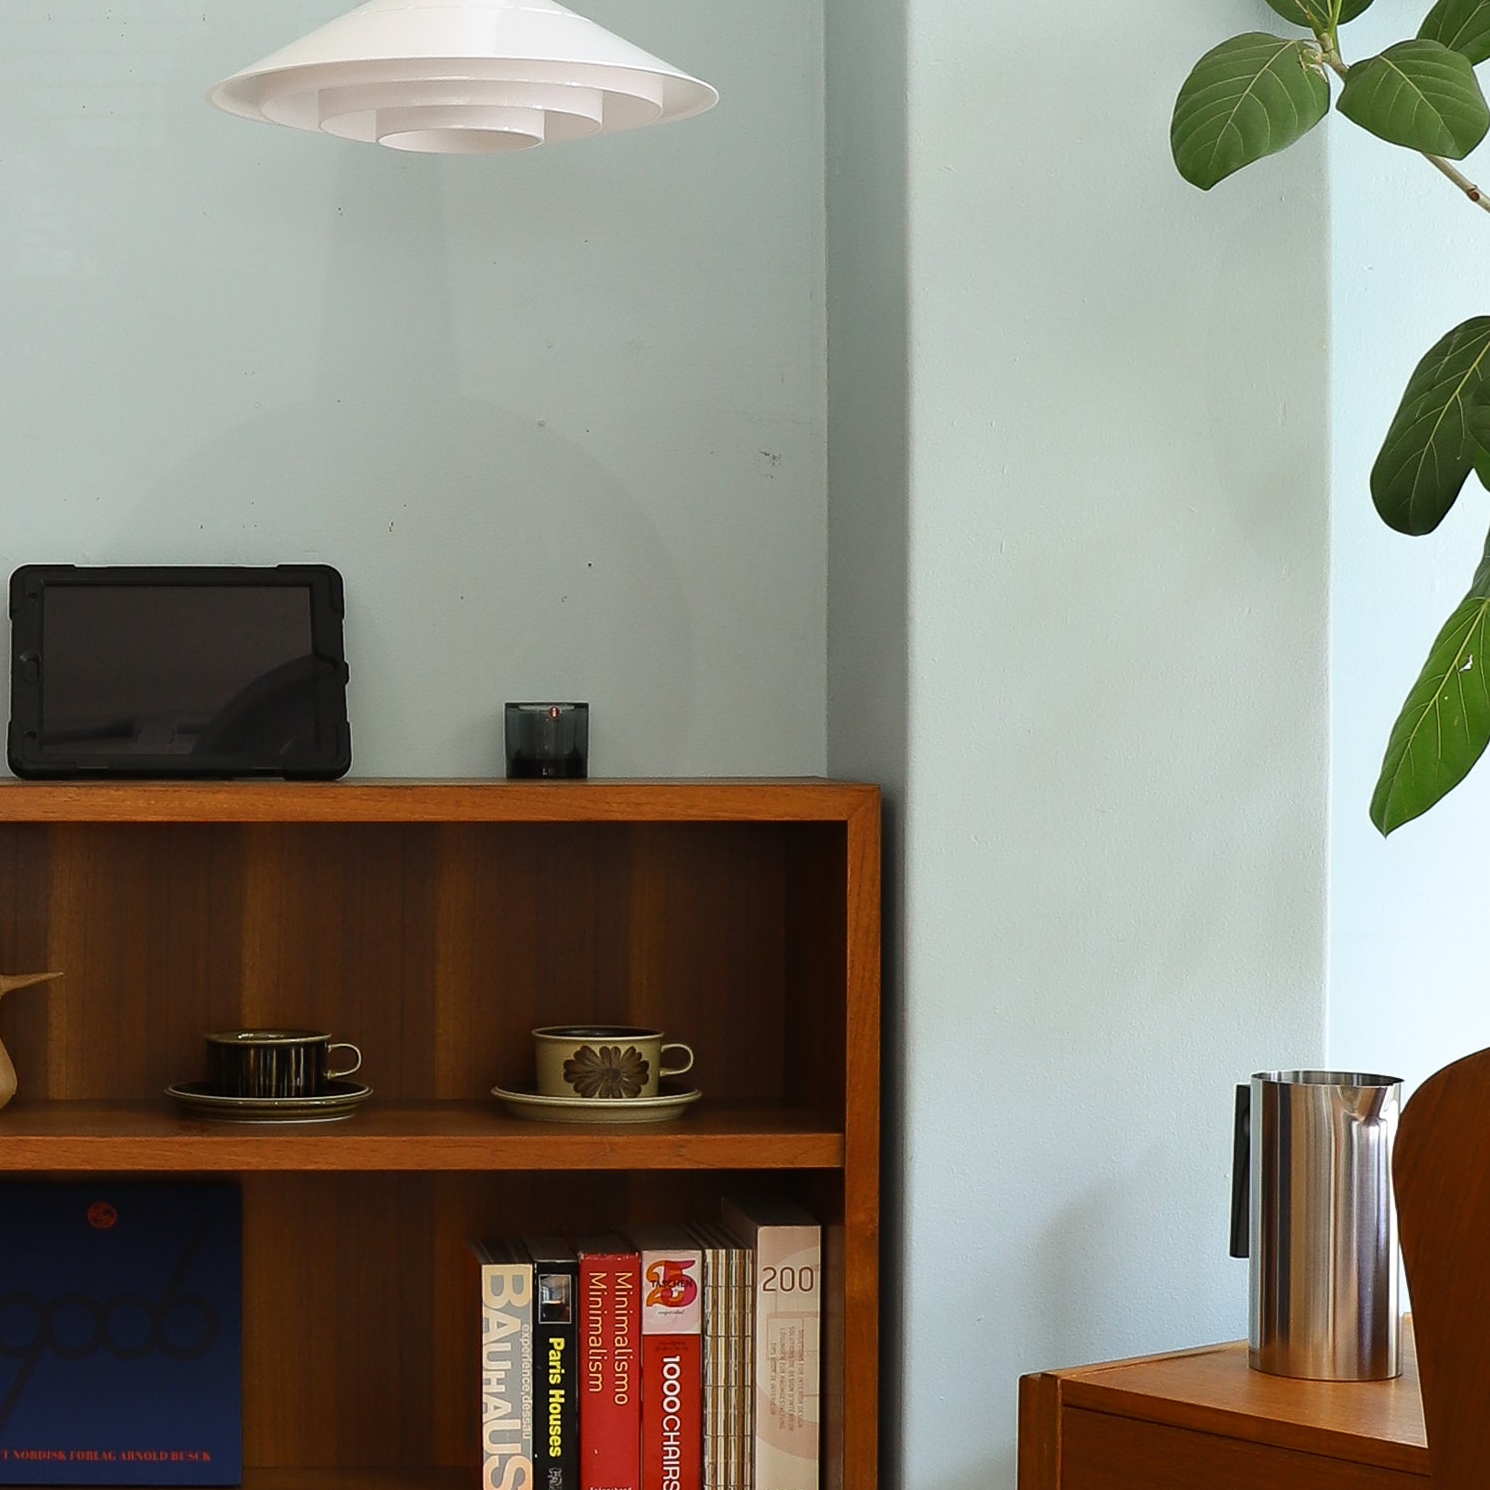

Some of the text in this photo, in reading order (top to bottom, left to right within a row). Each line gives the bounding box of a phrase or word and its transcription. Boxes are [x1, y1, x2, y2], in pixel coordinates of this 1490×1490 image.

[588, 1272, 608, 1393] Minimalism
[614, 1271, 629, 1406] Minimalismo
[650, 1279, 694, 1289] TASCHEN
[762, 1266, 815, 1292] 200
[548, 1337, 566, 1458] Paris Houses
